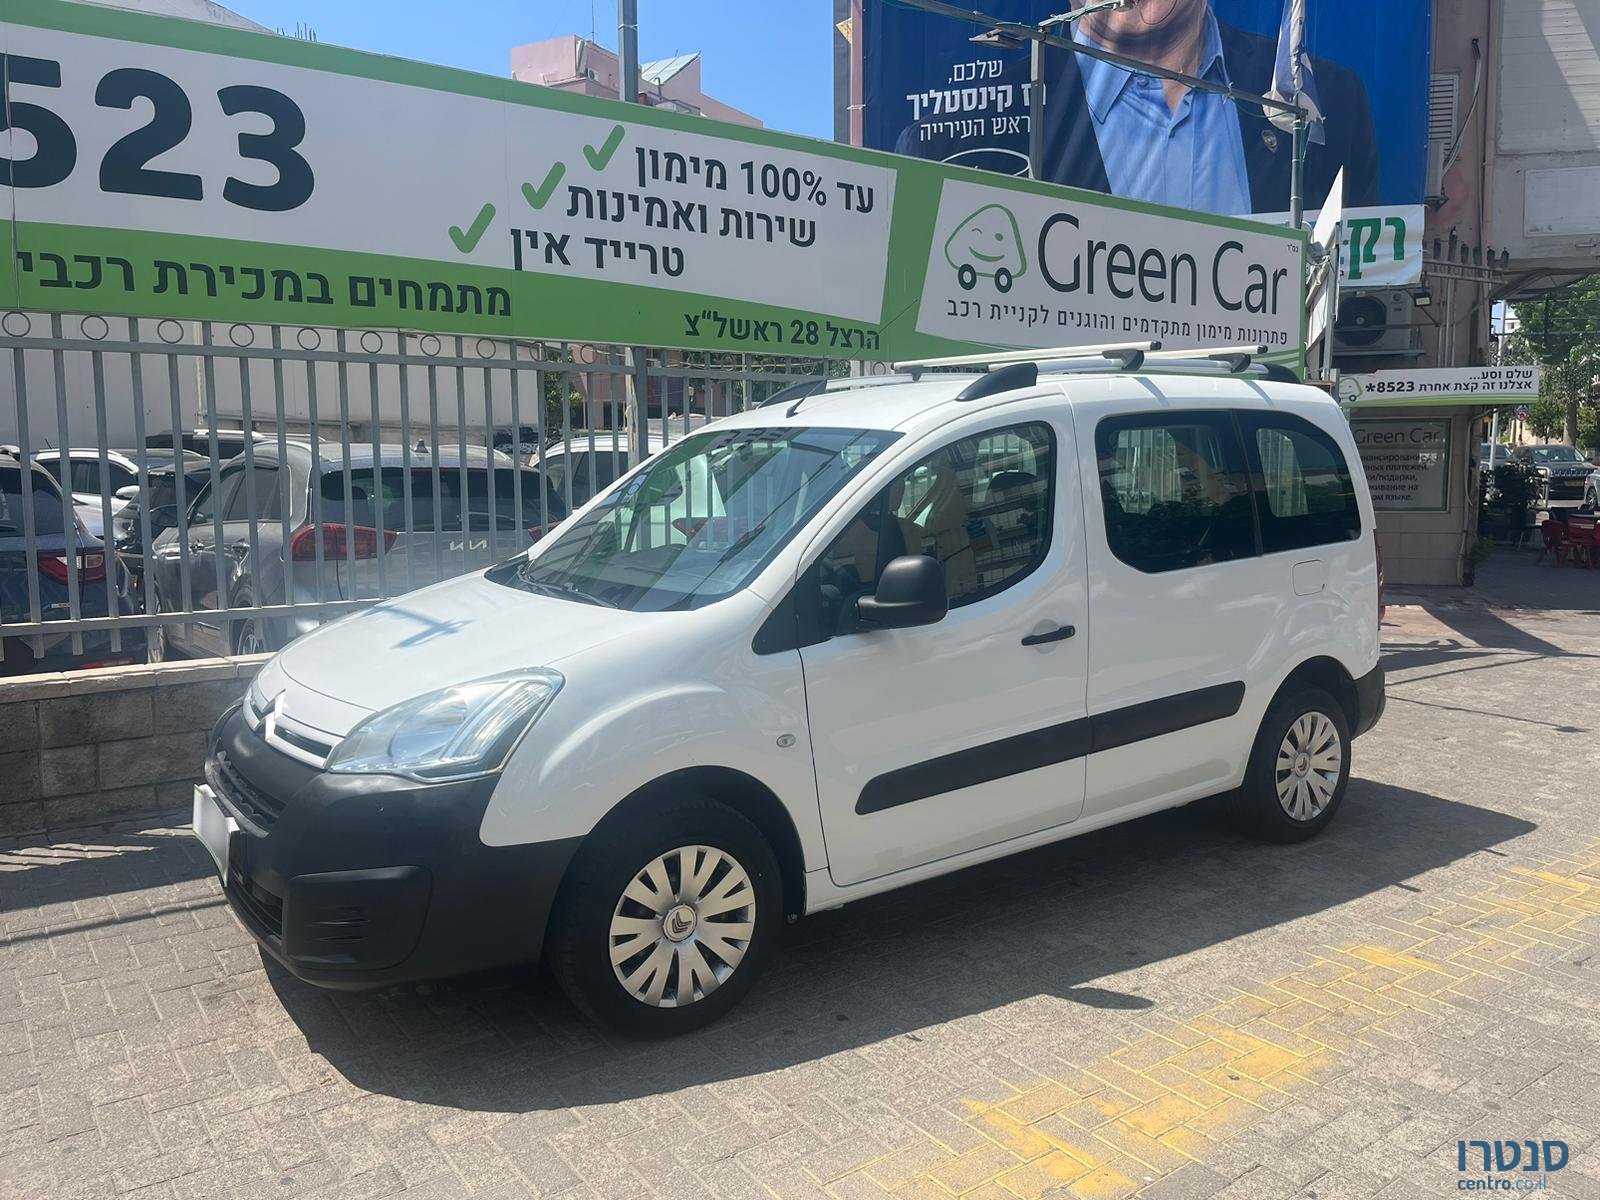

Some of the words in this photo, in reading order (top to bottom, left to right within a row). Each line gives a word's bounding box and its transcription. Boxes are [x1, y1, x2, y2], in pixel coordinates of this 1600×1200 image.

[948, 59, 1003, 84] שלכם,
[906, 85, 1013, 121] קינסטליך
[920, 119, 985, 141] העירייה
[635, 146, 728, 191] מימון
[740, 161, 827, 206] 100%
[566, 184, 708, 234] ואמינות
[836, 181, 875, 214] עד
[719, 208, 817, 248] שירות
[510, 228, 572, 271] אין
[583, 235, 685, 277] טרייד
[16, 251, 136, 291] רכבי
[1037, 212, 1197, 306] Green
[1211, 240, 1287, 315] Car
[153, 260, 334, 305] במכירת
[349, 275, 512, 317] מתמחים
[947, 299, 981, 318] רכב
[989, 304, 1050, 328] לקניית
[1057, 310, 1115, 330] והוגנים
[1122, 316, 1190, 338] מתקדמים
[790, 319, 819, 346] 28
[825, 321, 880, 350] הרצל
[1196, 323, 1232, 342] מימון
[1237, 328, 1288, 345] פתרונות
[1453, 381, 1479, 392] קצת
[1482, 380, 1496, 390] זה
[1500, 379, 1532, 390] אצלנו
[1505, 368, 1533, 379] שלם
[1418, 382, 1450, 392] אחרת
[1353, 428, 1405, 444] Green
[1409, 427, 1440, 443] Car
